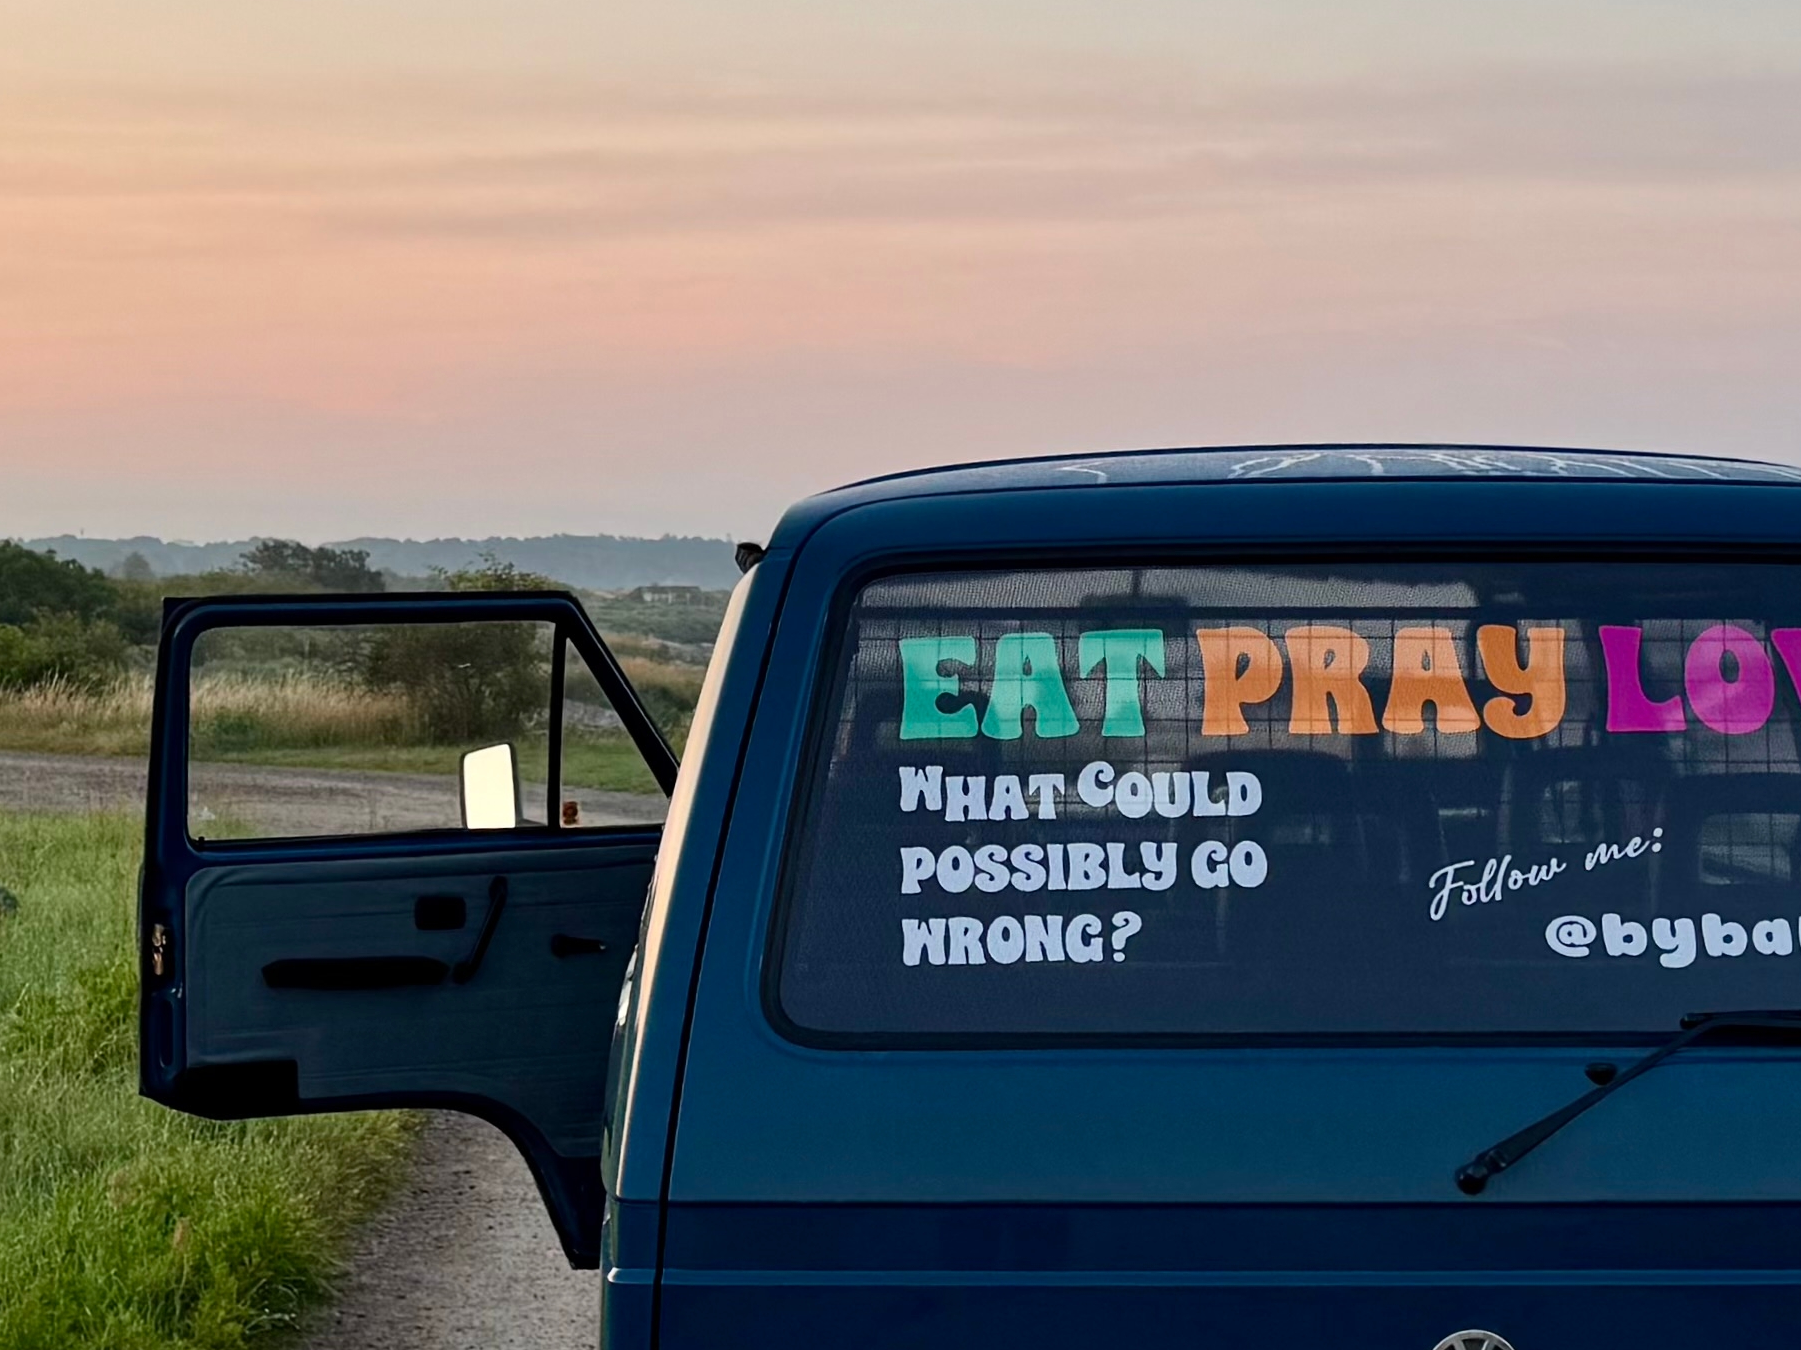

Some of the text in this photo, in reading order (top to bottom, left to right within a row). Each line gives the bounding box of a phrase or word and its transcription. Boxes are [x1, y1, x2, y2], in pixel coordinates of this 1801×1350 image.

[900, 629, 1165, 740] EAT
[1197, 625, 1566, 739] PRAY
[899, 761, 1262, 821] WHAT COULD
[900, 840, 1268, 894] POSSIBLY GO
[1429, 827, 1664, 921] Follow me:
[902, 910, 1142, 966] WRONG?
